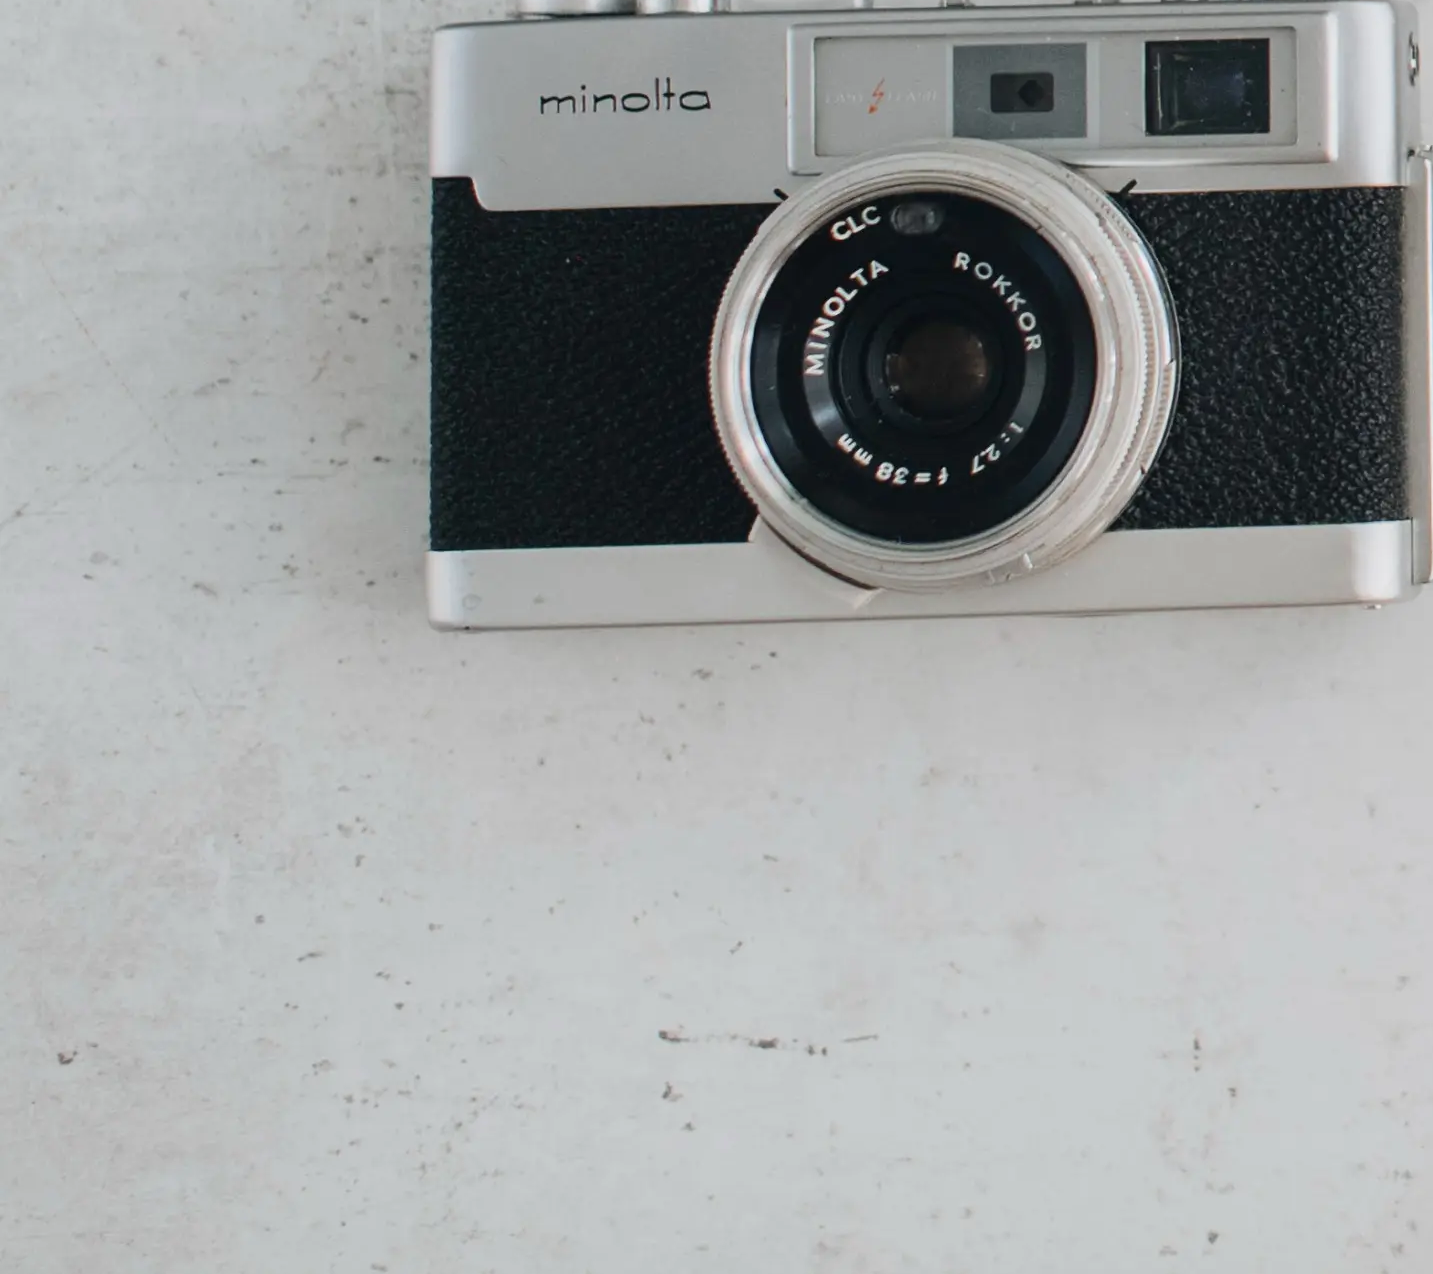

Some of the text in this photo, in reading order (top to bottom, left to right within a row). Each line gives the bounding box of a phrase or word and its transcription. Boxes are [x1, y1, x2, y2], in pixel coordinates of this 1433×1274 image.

[539, 76, 712, 115] minolta
[829, 205, 882, 243] CLC
[803, 251, 1043, 377] MINOLTA ROKKOR
